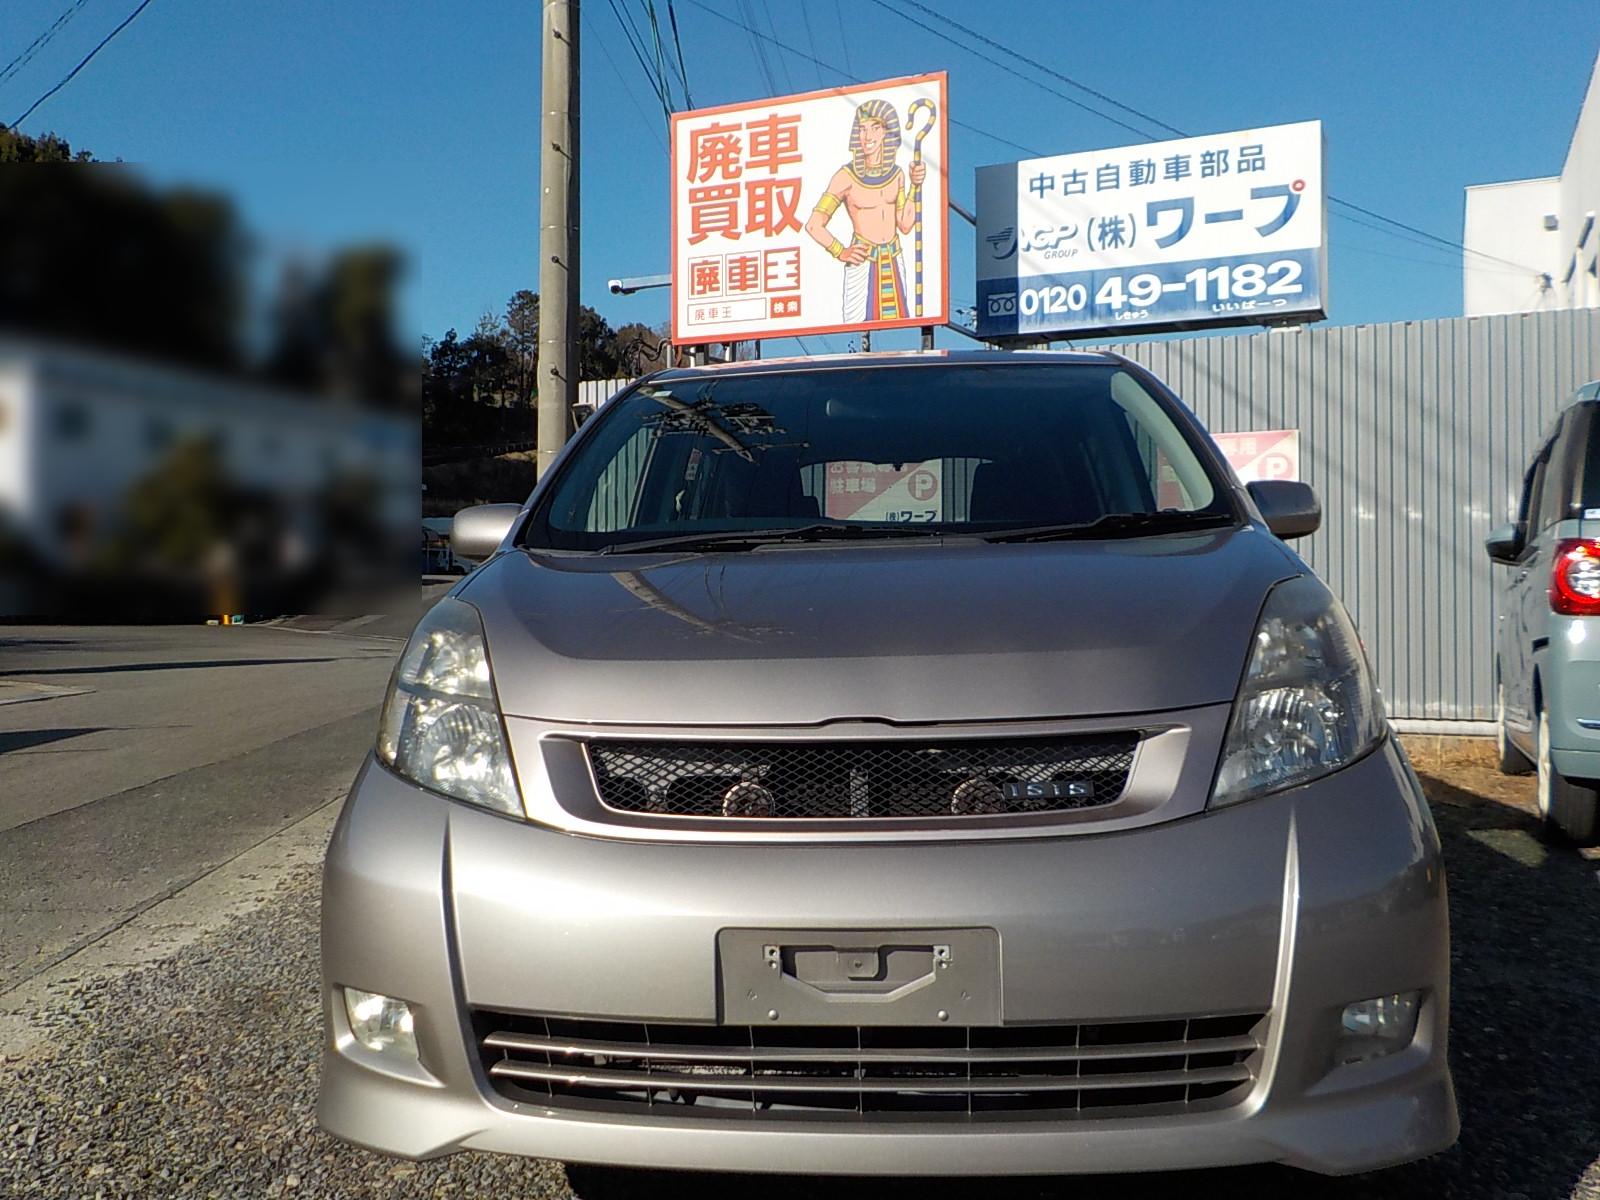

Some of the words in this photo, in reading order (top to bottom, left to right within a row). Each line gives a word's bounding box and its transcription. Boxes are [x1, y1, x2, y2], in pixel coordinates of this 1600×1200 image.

[686, 114, 803, 184] 廃車
[1029, 143, 1267, 200] 中古自動車部品
[687, 178, 804, 246] 買取
[1043, 248, 1079, 260] GROUP
[1019, 283, 1087, 316] 0120
[1095, 260, 1302, 310] 49-1182
[694, 306, 733, 321] 廃車王
[773, 301, 798, 315] 検索
[1114, 309, 1150, 321] しきゅう
[914, 474, 933, 497] P
